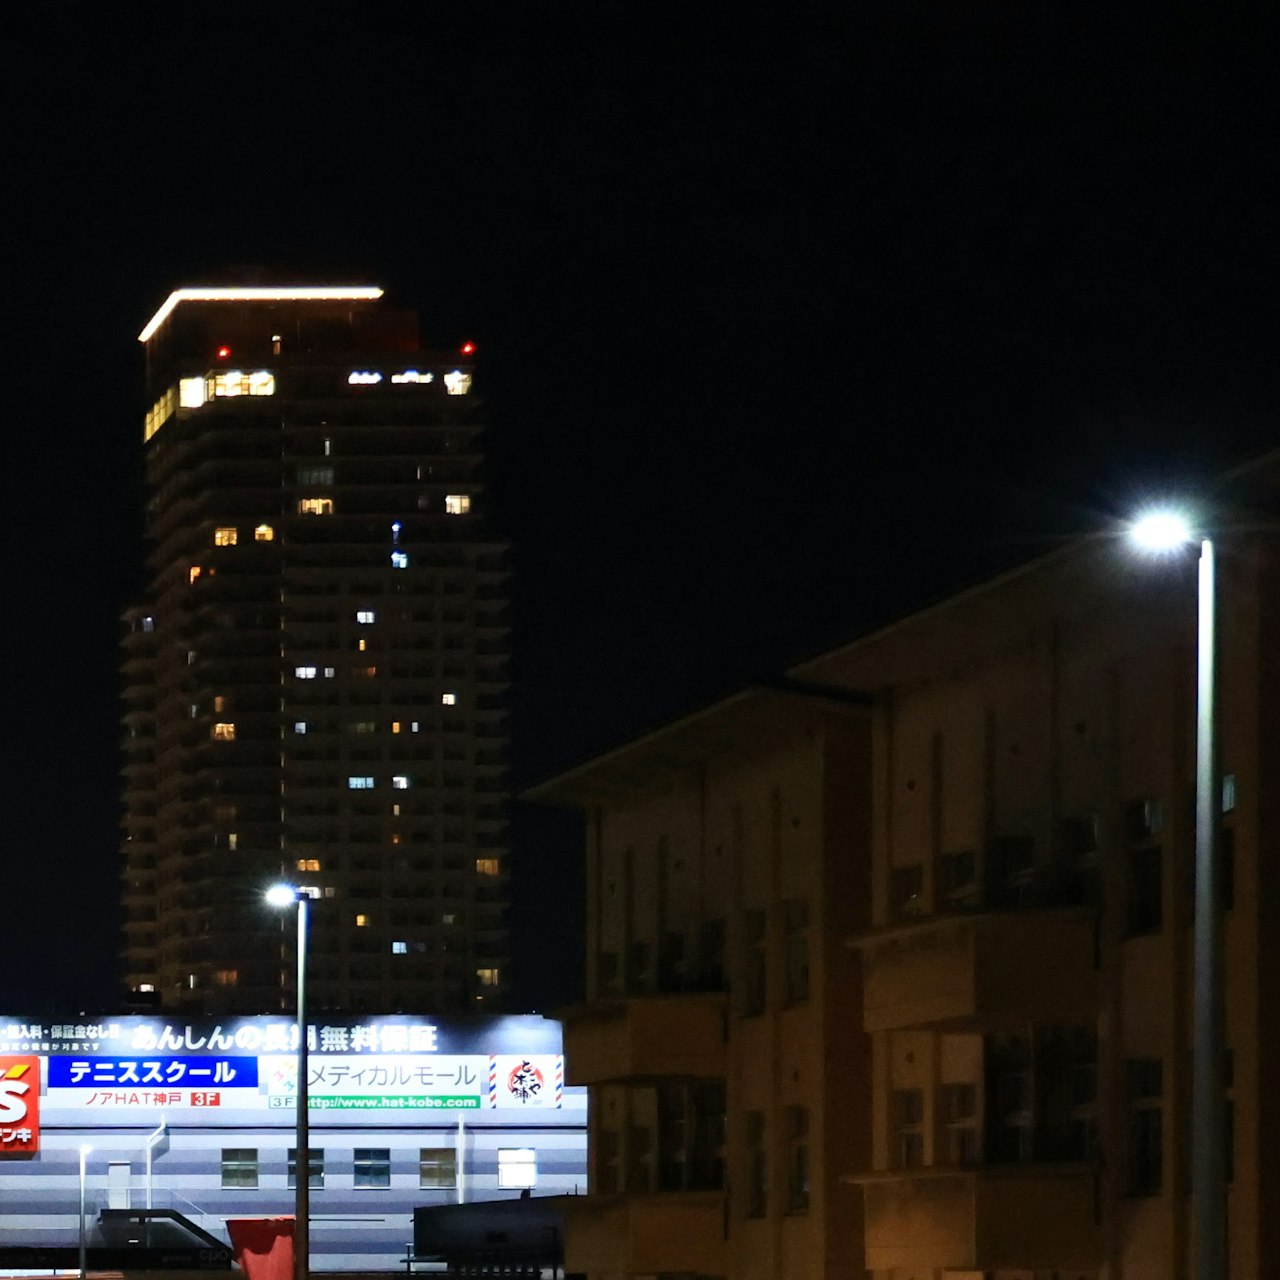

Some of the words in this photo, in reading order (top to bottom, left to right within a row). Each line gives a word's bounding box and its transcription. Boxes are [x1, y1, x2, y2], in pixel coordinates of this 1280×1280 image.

[70, 1060, 237, 1083] テニススクール
[307, 1065, 477, 1087] メディカルモール
[85, 1091, 182, 1106] ノアHAT神戸
[194, 1092, 216, 1106] 3F
[273, 1098, 293, 1107] 3F
[307, 1096, 476, 1109] ttp://www.hat-kobe.com
